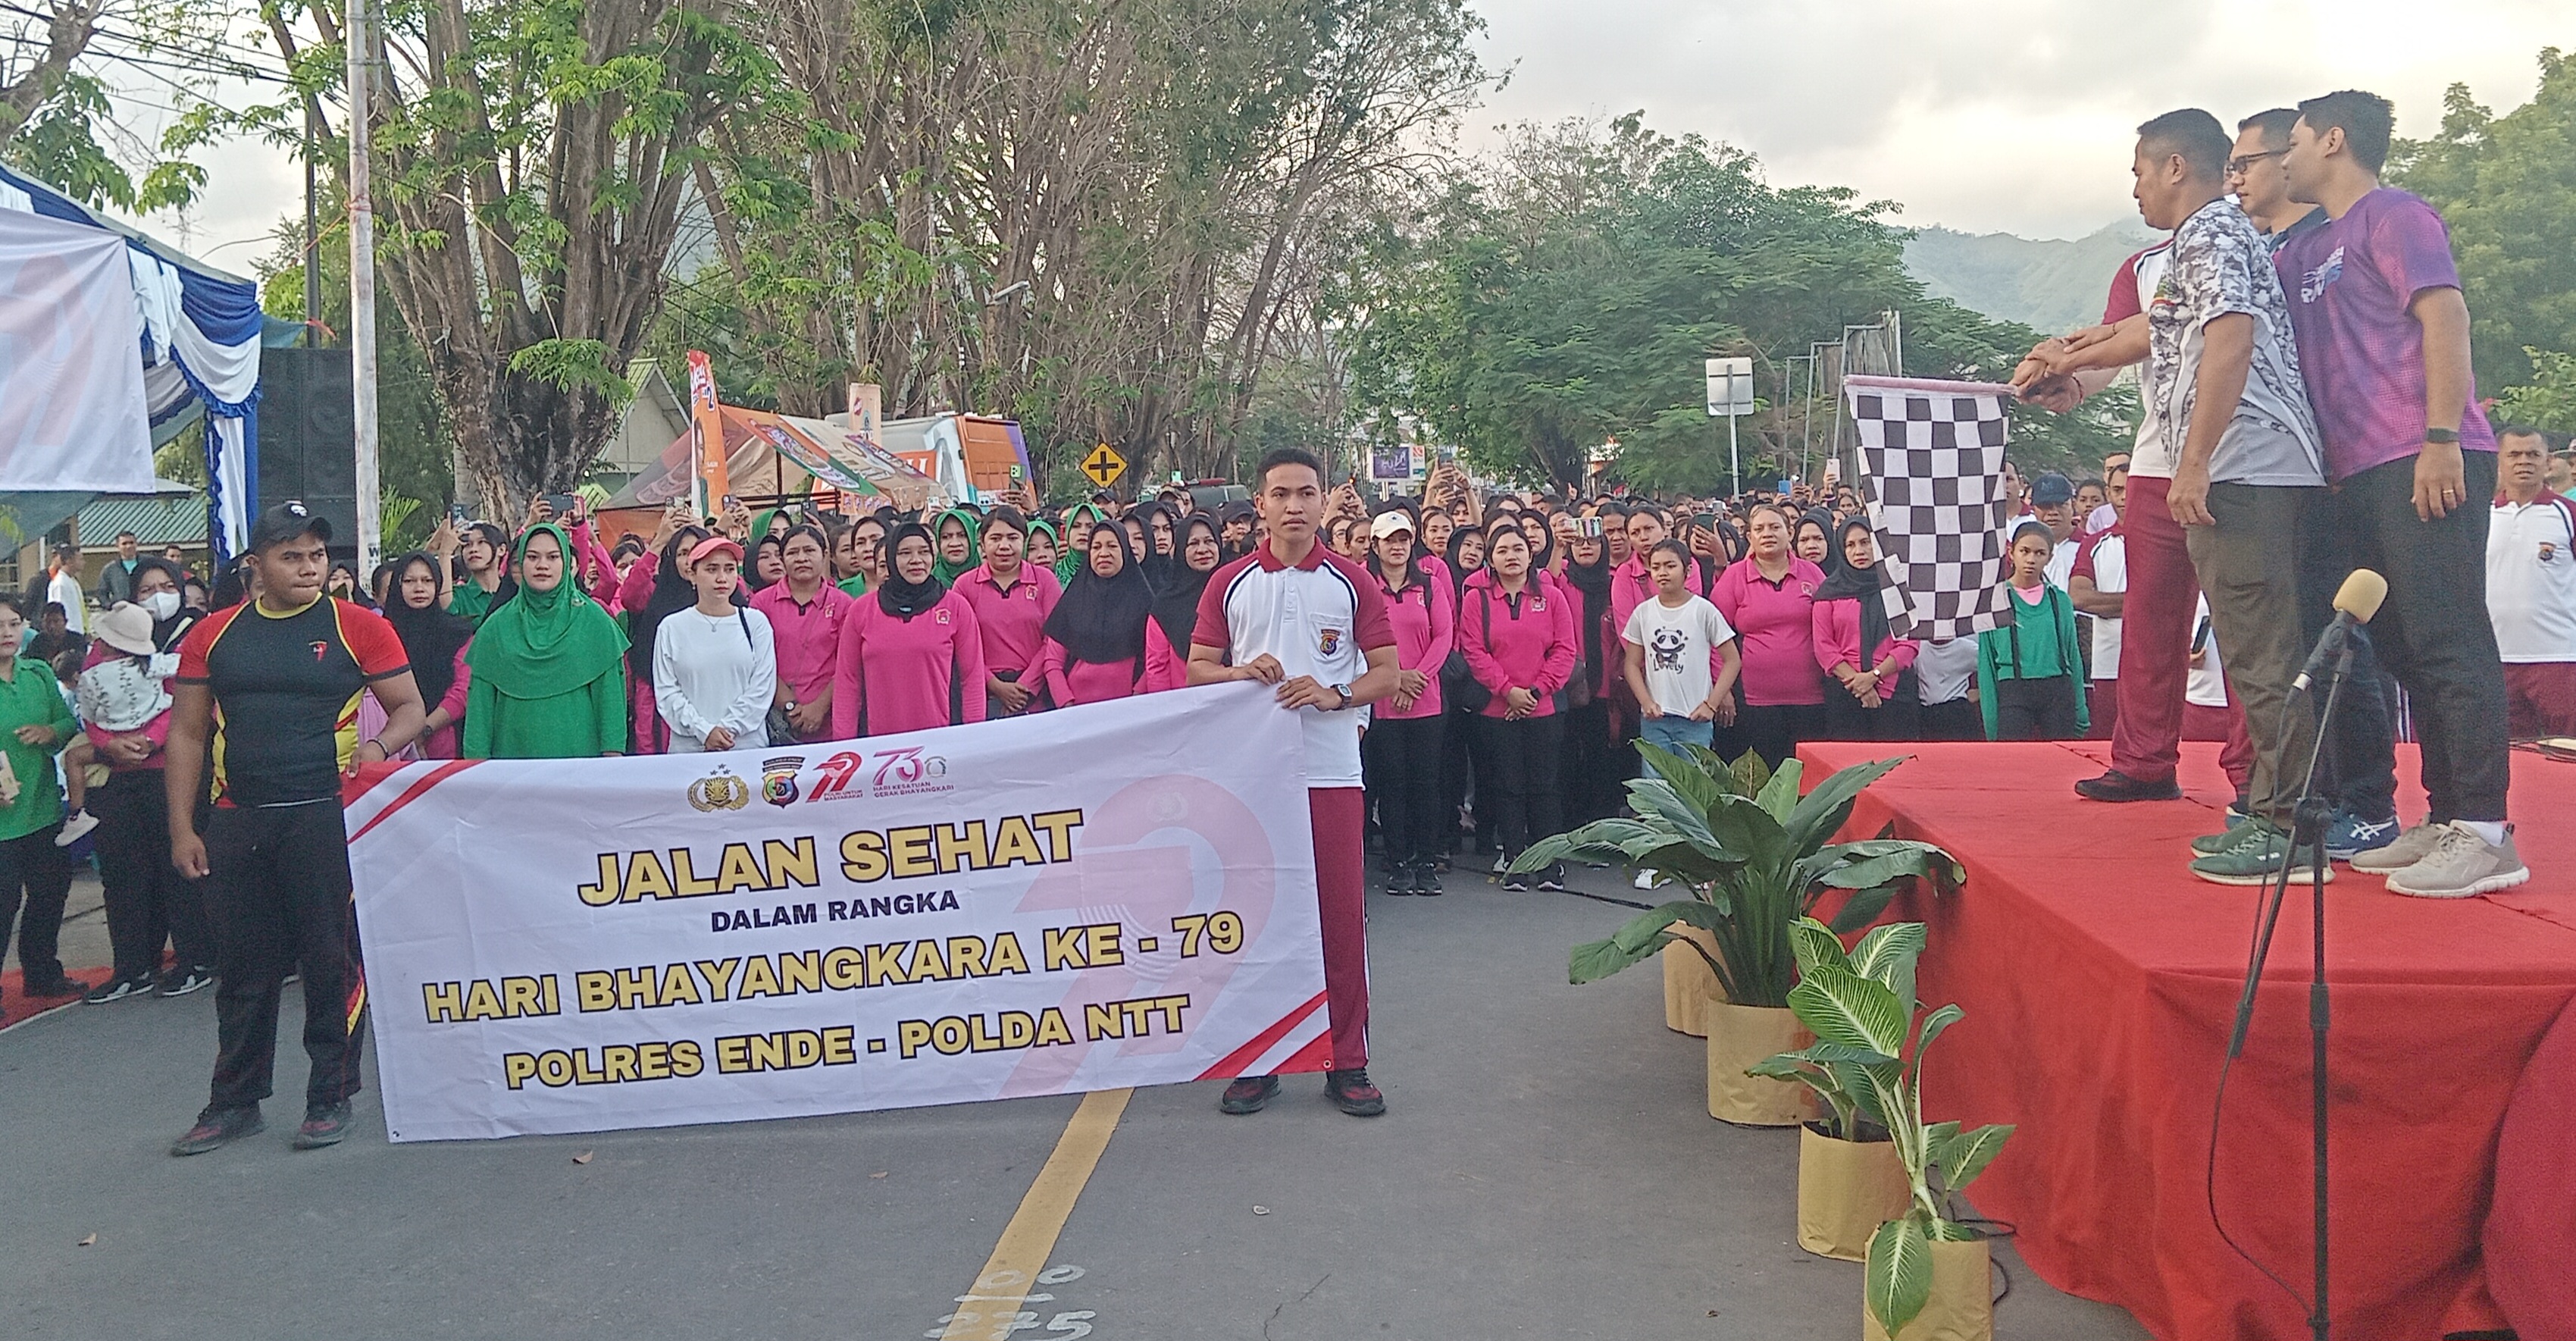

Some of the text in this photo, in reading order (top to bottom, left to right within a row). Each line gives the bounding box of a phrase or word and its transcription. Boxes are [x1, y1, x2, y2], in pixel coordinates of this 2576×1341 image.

[893, 781, 931, 790] KESATUAN
[577, 808, 1084, 907] JALAN SEHAT
[711, 889, 960, 932] DALAM RANGKA
[422, 973, 562, 1024] HARI
[575, 932, 1029, 1014] BHAYANGKARA
[1042, 921, 1125, 972] KE
[1172, 910, 1244, 959] 79
[503, 1039, 705, 1091] POLRES
[715, 1025, 856, 1075] ENDE
[898, 1007, 1075, 1059] POLDA
[1083, 994, 1191, 1042] NTT
